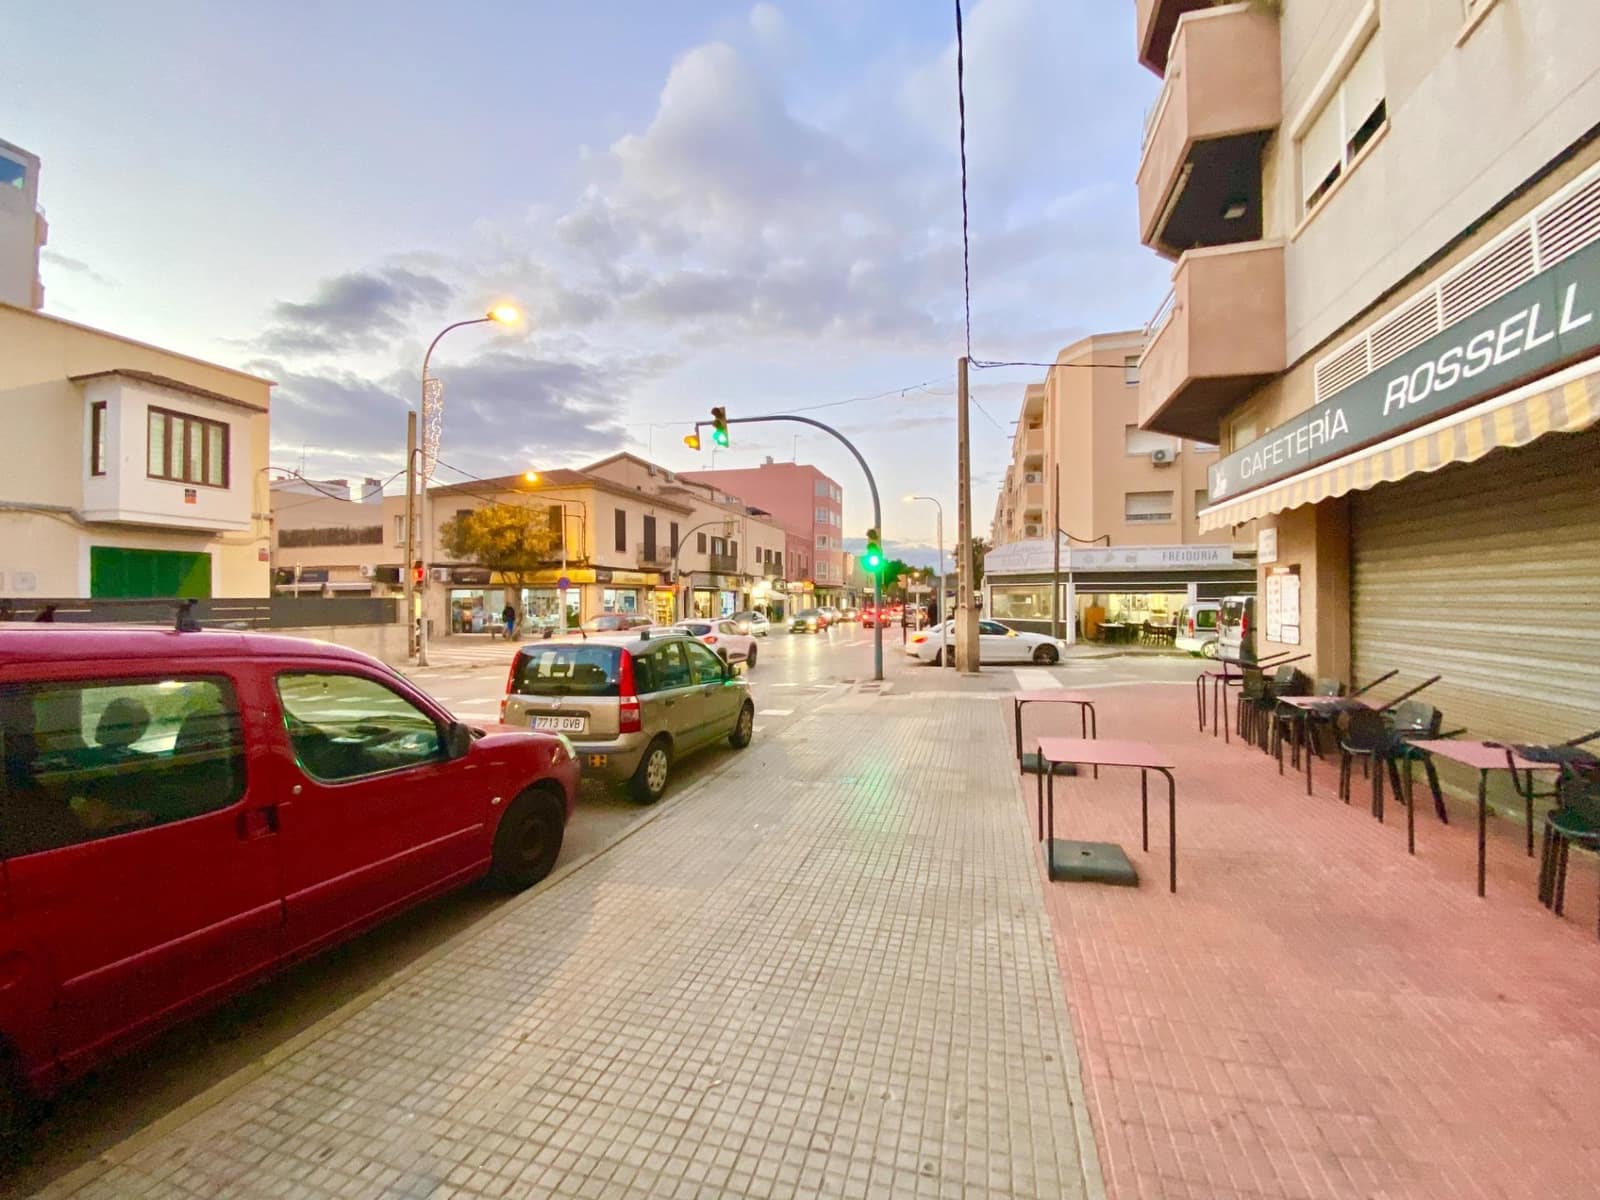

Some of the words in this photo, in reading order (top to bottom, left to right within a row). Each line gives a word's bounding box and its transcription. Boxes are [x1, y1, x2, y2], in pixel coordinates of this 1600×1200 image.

[1240, 408, 1349, 480] CAFETERÍA
[1382, 281, 1592, 416] ROSSELL
[537, 717, 559, 728] 7713
[563, 718, 581, 729] GVB
